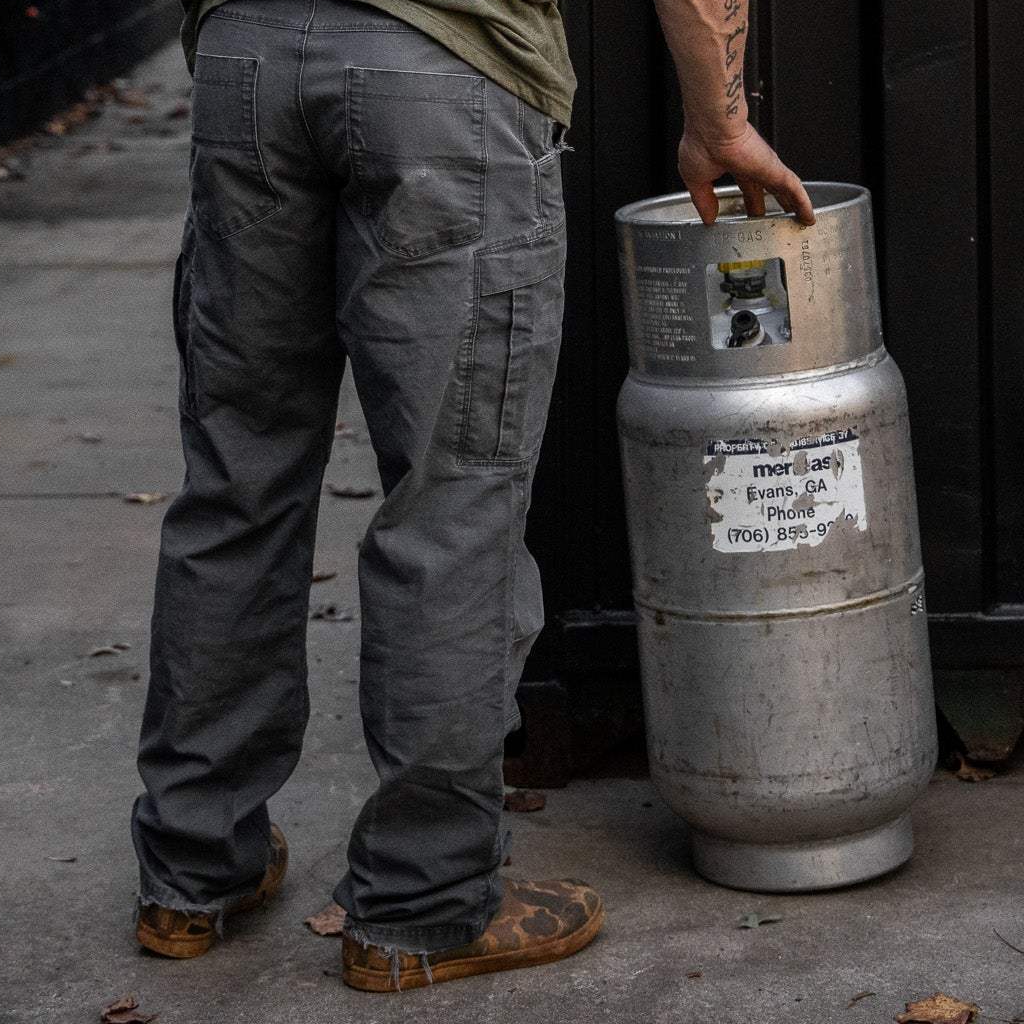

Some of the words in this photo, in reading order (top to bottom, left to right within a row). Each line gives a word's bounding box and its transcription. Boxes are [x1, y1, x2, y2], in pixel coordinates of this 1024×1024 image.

[753, 456, 832, 477] meras
[746, 484, 798, 501] Evans,
[805, 478, 827, 493] GA
[767, 506, 815, 521] Phone
[727, 527, 769, 544] (706)
